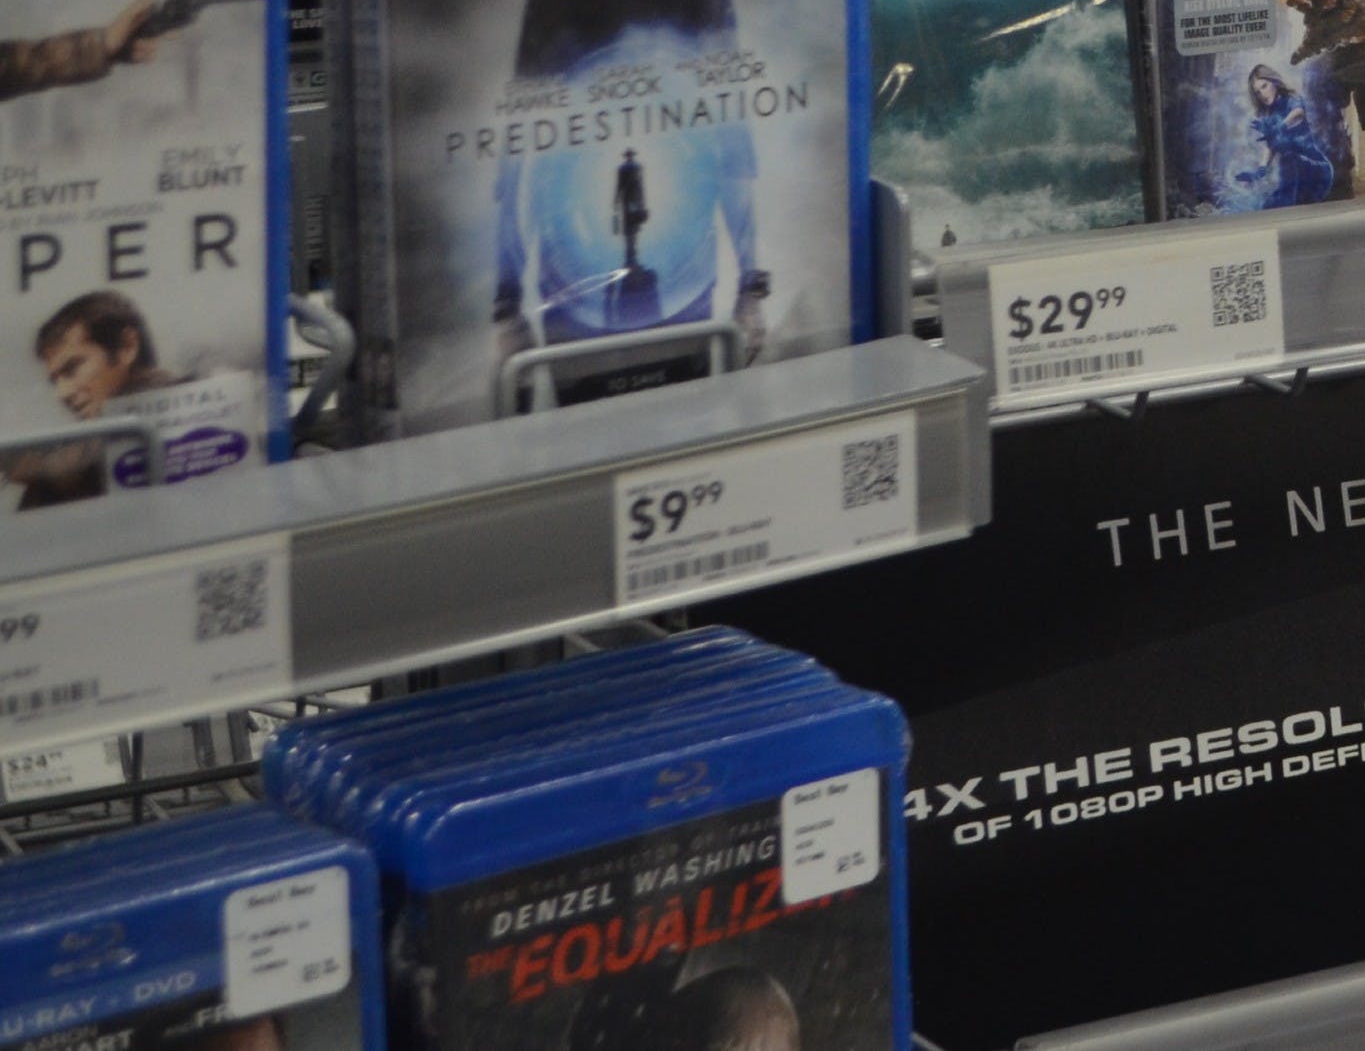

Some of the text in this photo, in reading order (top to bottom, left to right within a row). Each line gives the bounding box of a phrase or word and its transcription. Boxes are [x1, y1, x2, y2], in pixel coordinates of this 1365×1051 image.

[586, 74, 663, 105] SNOOK
[695, 60, 769, 88] TAYLOR
[444, 81, 811, 165] PREDESTINATION
[158, 163, 246, 194] BLUNT
[18, 212, 240, 294] PER
[1096, 499, 1237, 569] THE
[902, 774, 986, 822] 4X
[999, 747, 1134, 802] THE
[952, 814, 1013, 847] OF
[1021, 784, 1164, 832] 1080P
[1172, 760, 1274, 802] HIGH
[490, 834, 778, 940] DENZEL WASHING
[509, 867, 840, 1006] EQUALIZ
[133, 970, 199, 1003] DVD
